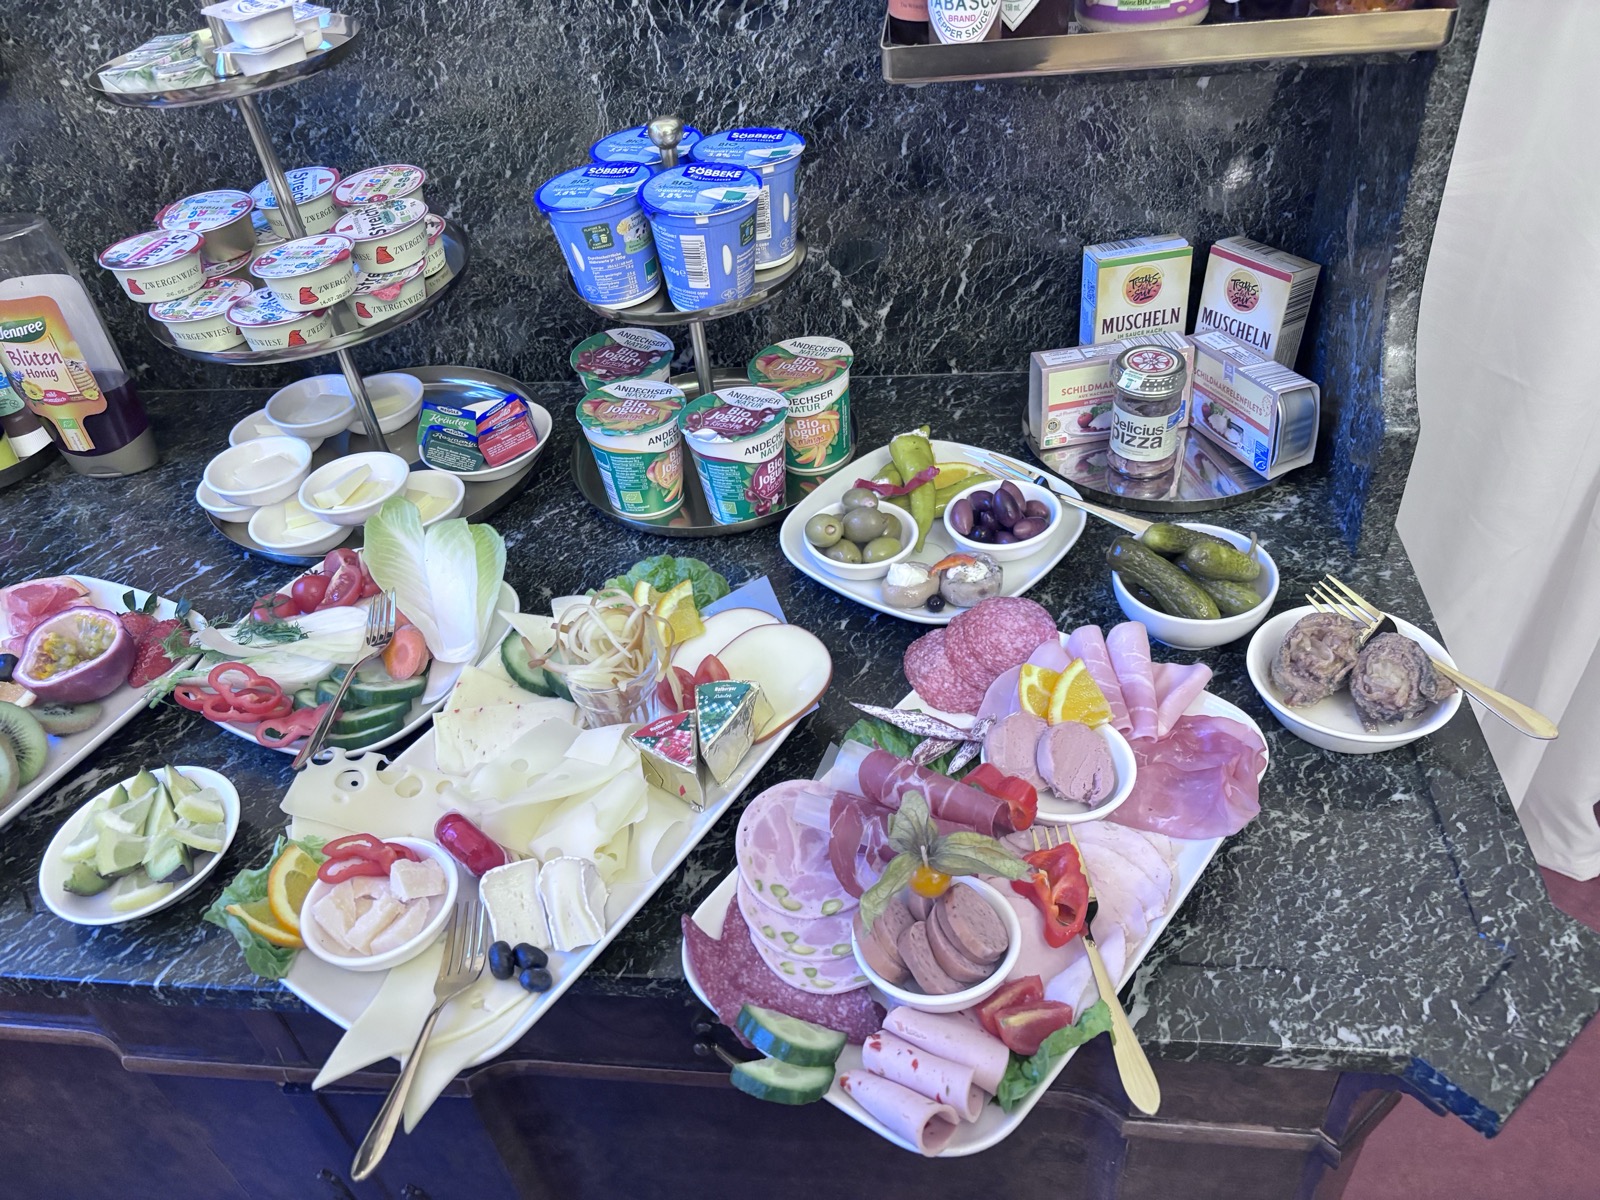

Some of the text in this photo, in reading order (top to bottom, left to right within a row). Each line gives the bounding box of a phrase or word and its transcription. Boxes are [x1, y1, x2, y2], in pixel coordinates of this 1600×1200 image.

[948, 14, 977, 23] BRAND
[935, 10, 989, 39] PEPPER SAUCE
[731, 132, 784, 140] SÖBBEKE
[587, 166, 639, 175] SÖBBEKE
[687, 166, 743, 179] SÖBBEKE
[658, 191, 683, 199] 3,8%
[371, 289, 426, 315] ZWERGENWIESE
[1101, 306, 1182, 336] MUSCHELN
[1201, 306, 1272, 350] MUSCHELN
[617, 330, 668, 348] ANDECHSER
[1125, 330, 1144, 338] SAUCE
[624, 340, 653, 351] NATUR
[789, 341, 844, 353] ANDECHSER
[616, 347, 639, 358] Bio
[798, 349, 828, 358] NATUR
[6, 349, 63, 368] Blüten
[793, 356, 817, 367] Bio
[26, 367, 59, 382] Honig
[614, 384, 673, 395] ANDECHSER
[1192, 366, 1263, 417] SCHILDMAKRELENFILETS
[727, 390, 781, 405] ANDECHSER
[622, 399, 648, 408] Bio
[734, 399, 764, 409] NATUR
[788, 403, 821, 414] NATUR
[727, 407, 752, 418] Bio
[429, 413, 470, 427] Kräuter
[796, 418, 819, 430] Bio
[1113, 412, 1165, 436] Delicius
